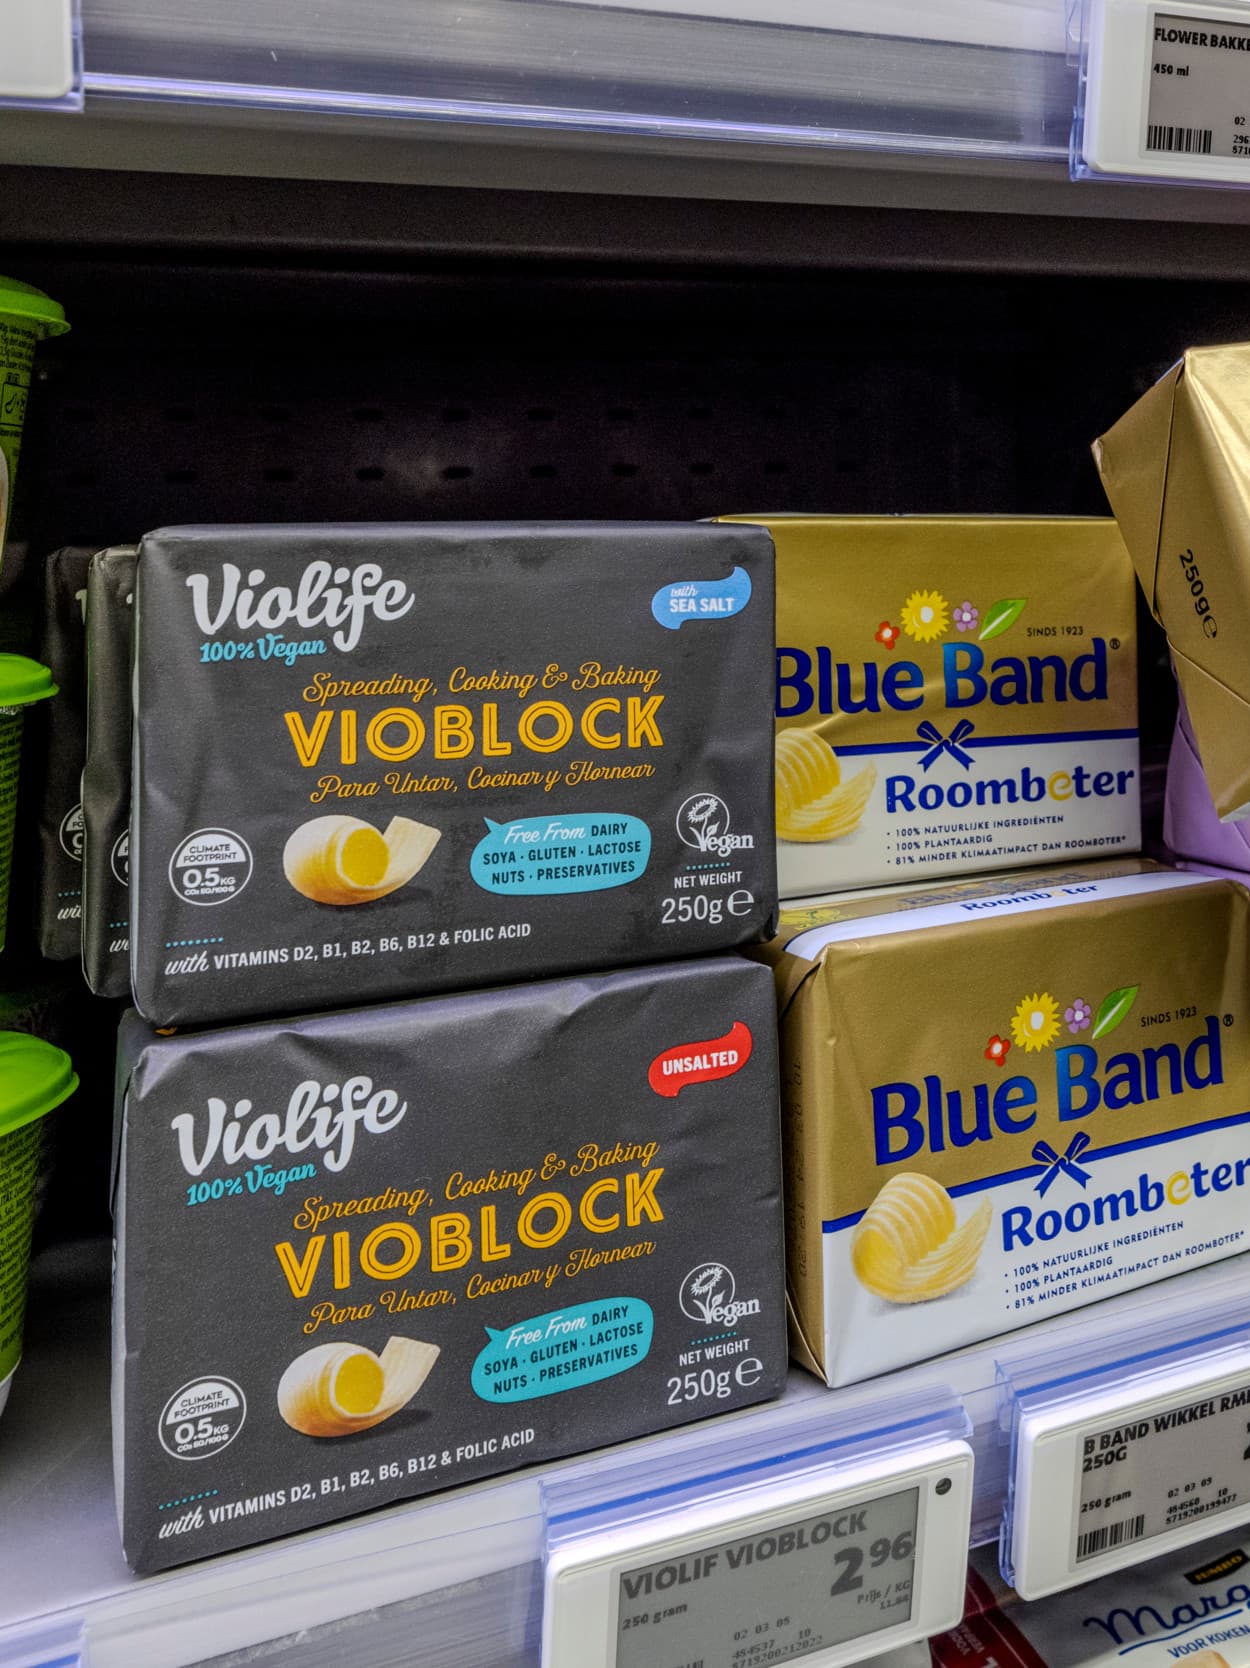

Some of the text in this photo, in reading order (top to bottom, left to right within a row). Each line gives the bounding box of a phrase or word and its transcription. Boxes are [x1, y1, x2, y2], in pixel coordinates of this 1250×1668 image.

[1154, 27, 1208, 47] FLOWER
[1153, 63, 1189, 77] 450 ml
[186, 559, 416, 653] Violife
[669, 597, 734, 613] SEA SALT
[670, 584, 698, 599] with
[1026, 625, 1084, 638] SINDS 1923
[199, 632, 327, 667] 100% Vegan
[303, 661, 662, 707] Spreading, Cooking & Baking
[775, 637, 1109, 718] Blue Band
[284, 695, 665, 768] VIOBLOCK
[310, 757, 656, 804] Para Untar, Cocinar y Hornear
[503, 821, 628, 845] Free From DAIRY
[697, 829, 755, 857] Vegan
[183, 851, 237, 864] FOOTPRINT
[190, 843, 231, 854] CLIMATE
[483, 840, 641, 865] SOYA GLUTEN LACTOSE
[491, 860, 635, 885] NUTS PRESERVATIVES
[674, 871, 743, 889] NET WEIGHT
[164, 923, 532, 975] with VITAMINS D2, B1, B2, B6, B12 FOLIC ACID
[1140, 1006, 1199, 1028] SINDS 1923
[661, 1048, 738, 1077] UNSALTED
[870, 1073, 1038, 1166] Blue
[1054, 1015, 1225, 1121] Band
[170, 1074, 407, 1176] Violife
[185, 1162, 317, 1207] 100% Vegan
[274, 1167, 665, 1299] VIOBLOCK
[1012, 1219, 1185, 1277] 100% NATUURLIJKE INGREDIËNTEN
[1014, 1255, 1114, 1293] 100% PLANTAARDIG
[1014, 1295, 1036, 1309] 81%
[1038, 1281, 1078, 1303] MINDER
[1081, 1256, 1159, 1290] KLIMAATIMPACT
[1162, 1249, 1182, 1265] DAN
[1084, 1438, 1096, 1455] B
[1100, 1421, 1151, 1450] BAND
[1153, 1403, 1216, 1434] WIKKEL
[1082, 1445, 1128, 1473] 250G
[1081, 1489, 1132, 1513] 250 gram
[622, 1509, 867, 1600] VIOLIF VIOBLOCK
[1194, 1553, 1243, 1582] JUMBO
[622, 1603, 688, 1630] 250 gram
[1166, 1635, 1208, 1659] VOOR
